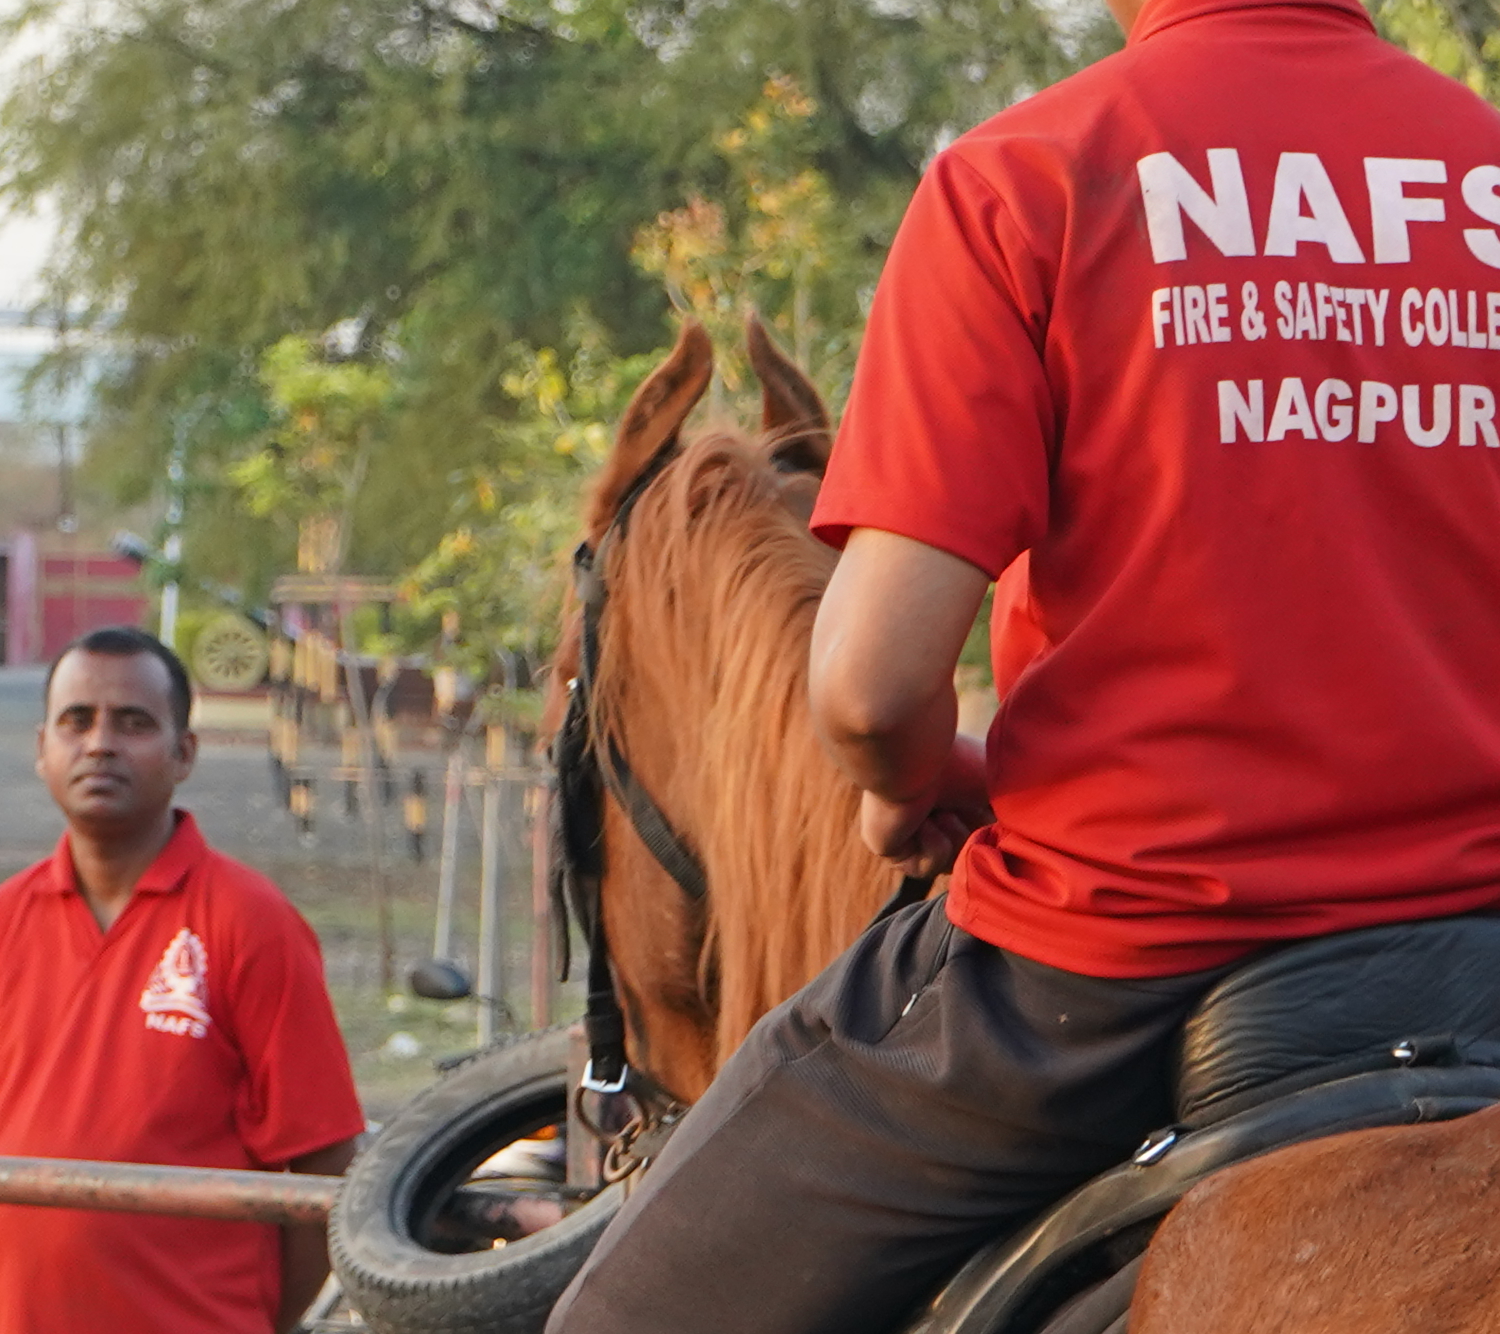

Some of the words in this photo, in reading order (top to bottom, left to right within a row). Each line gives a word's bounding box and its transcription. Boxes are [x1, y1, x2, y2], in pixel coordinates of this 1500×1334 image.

[1152, 283, 1231, 348] FIRE
[1241, 281, 1267, 341] &
[1274, 281, 1389, 346] SAFETY
[1218, 378, 1500, 447] NAGPUR
